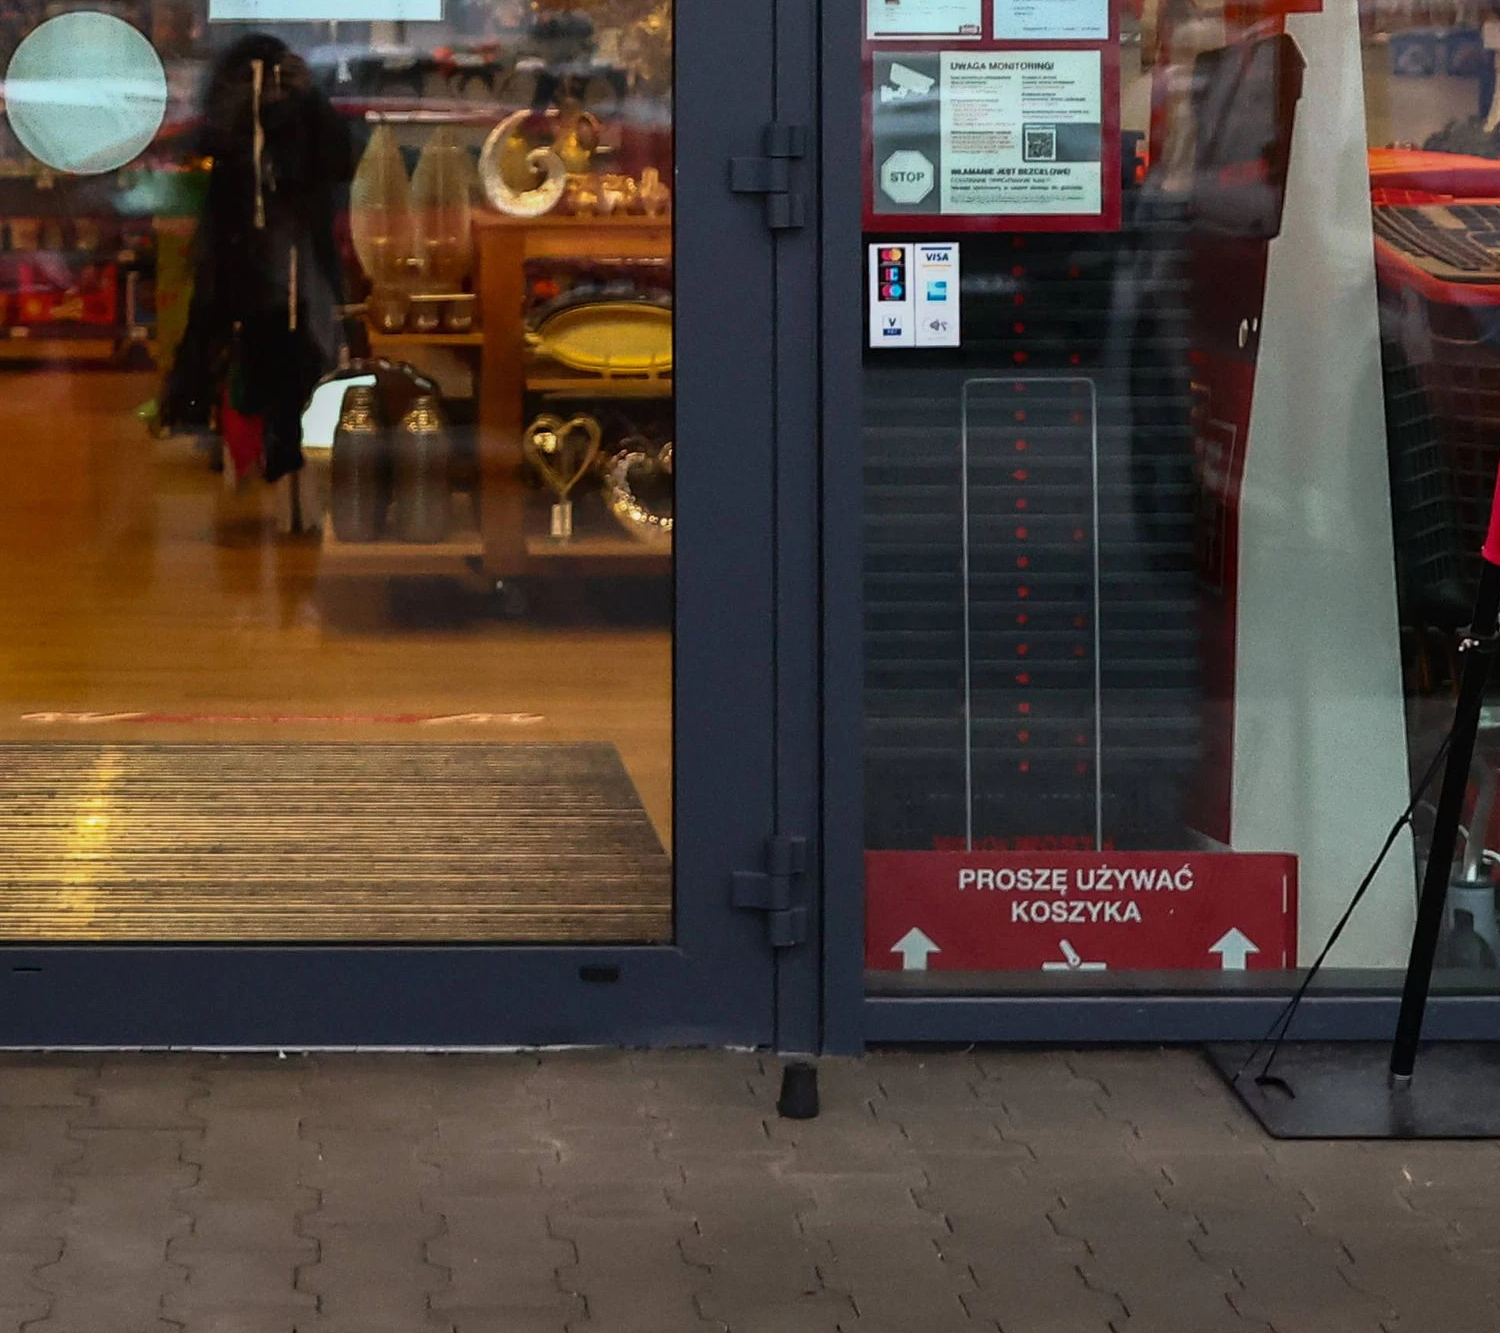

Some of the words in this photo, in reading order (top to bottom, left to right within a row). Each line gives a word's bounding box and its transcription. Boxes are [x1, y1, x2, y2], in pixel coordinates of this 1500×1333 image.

[950, 61, 986, 70] UWAGA
[890, 171, 925, 182] STOP
[926, 253, 949, 261] VISA
[958, 868, 1068, 895] PROSZĘ
[1076, 863, 1194, 891] UŻYWAĆ
[1011, 900, 1142, 923] KOSZYKA
